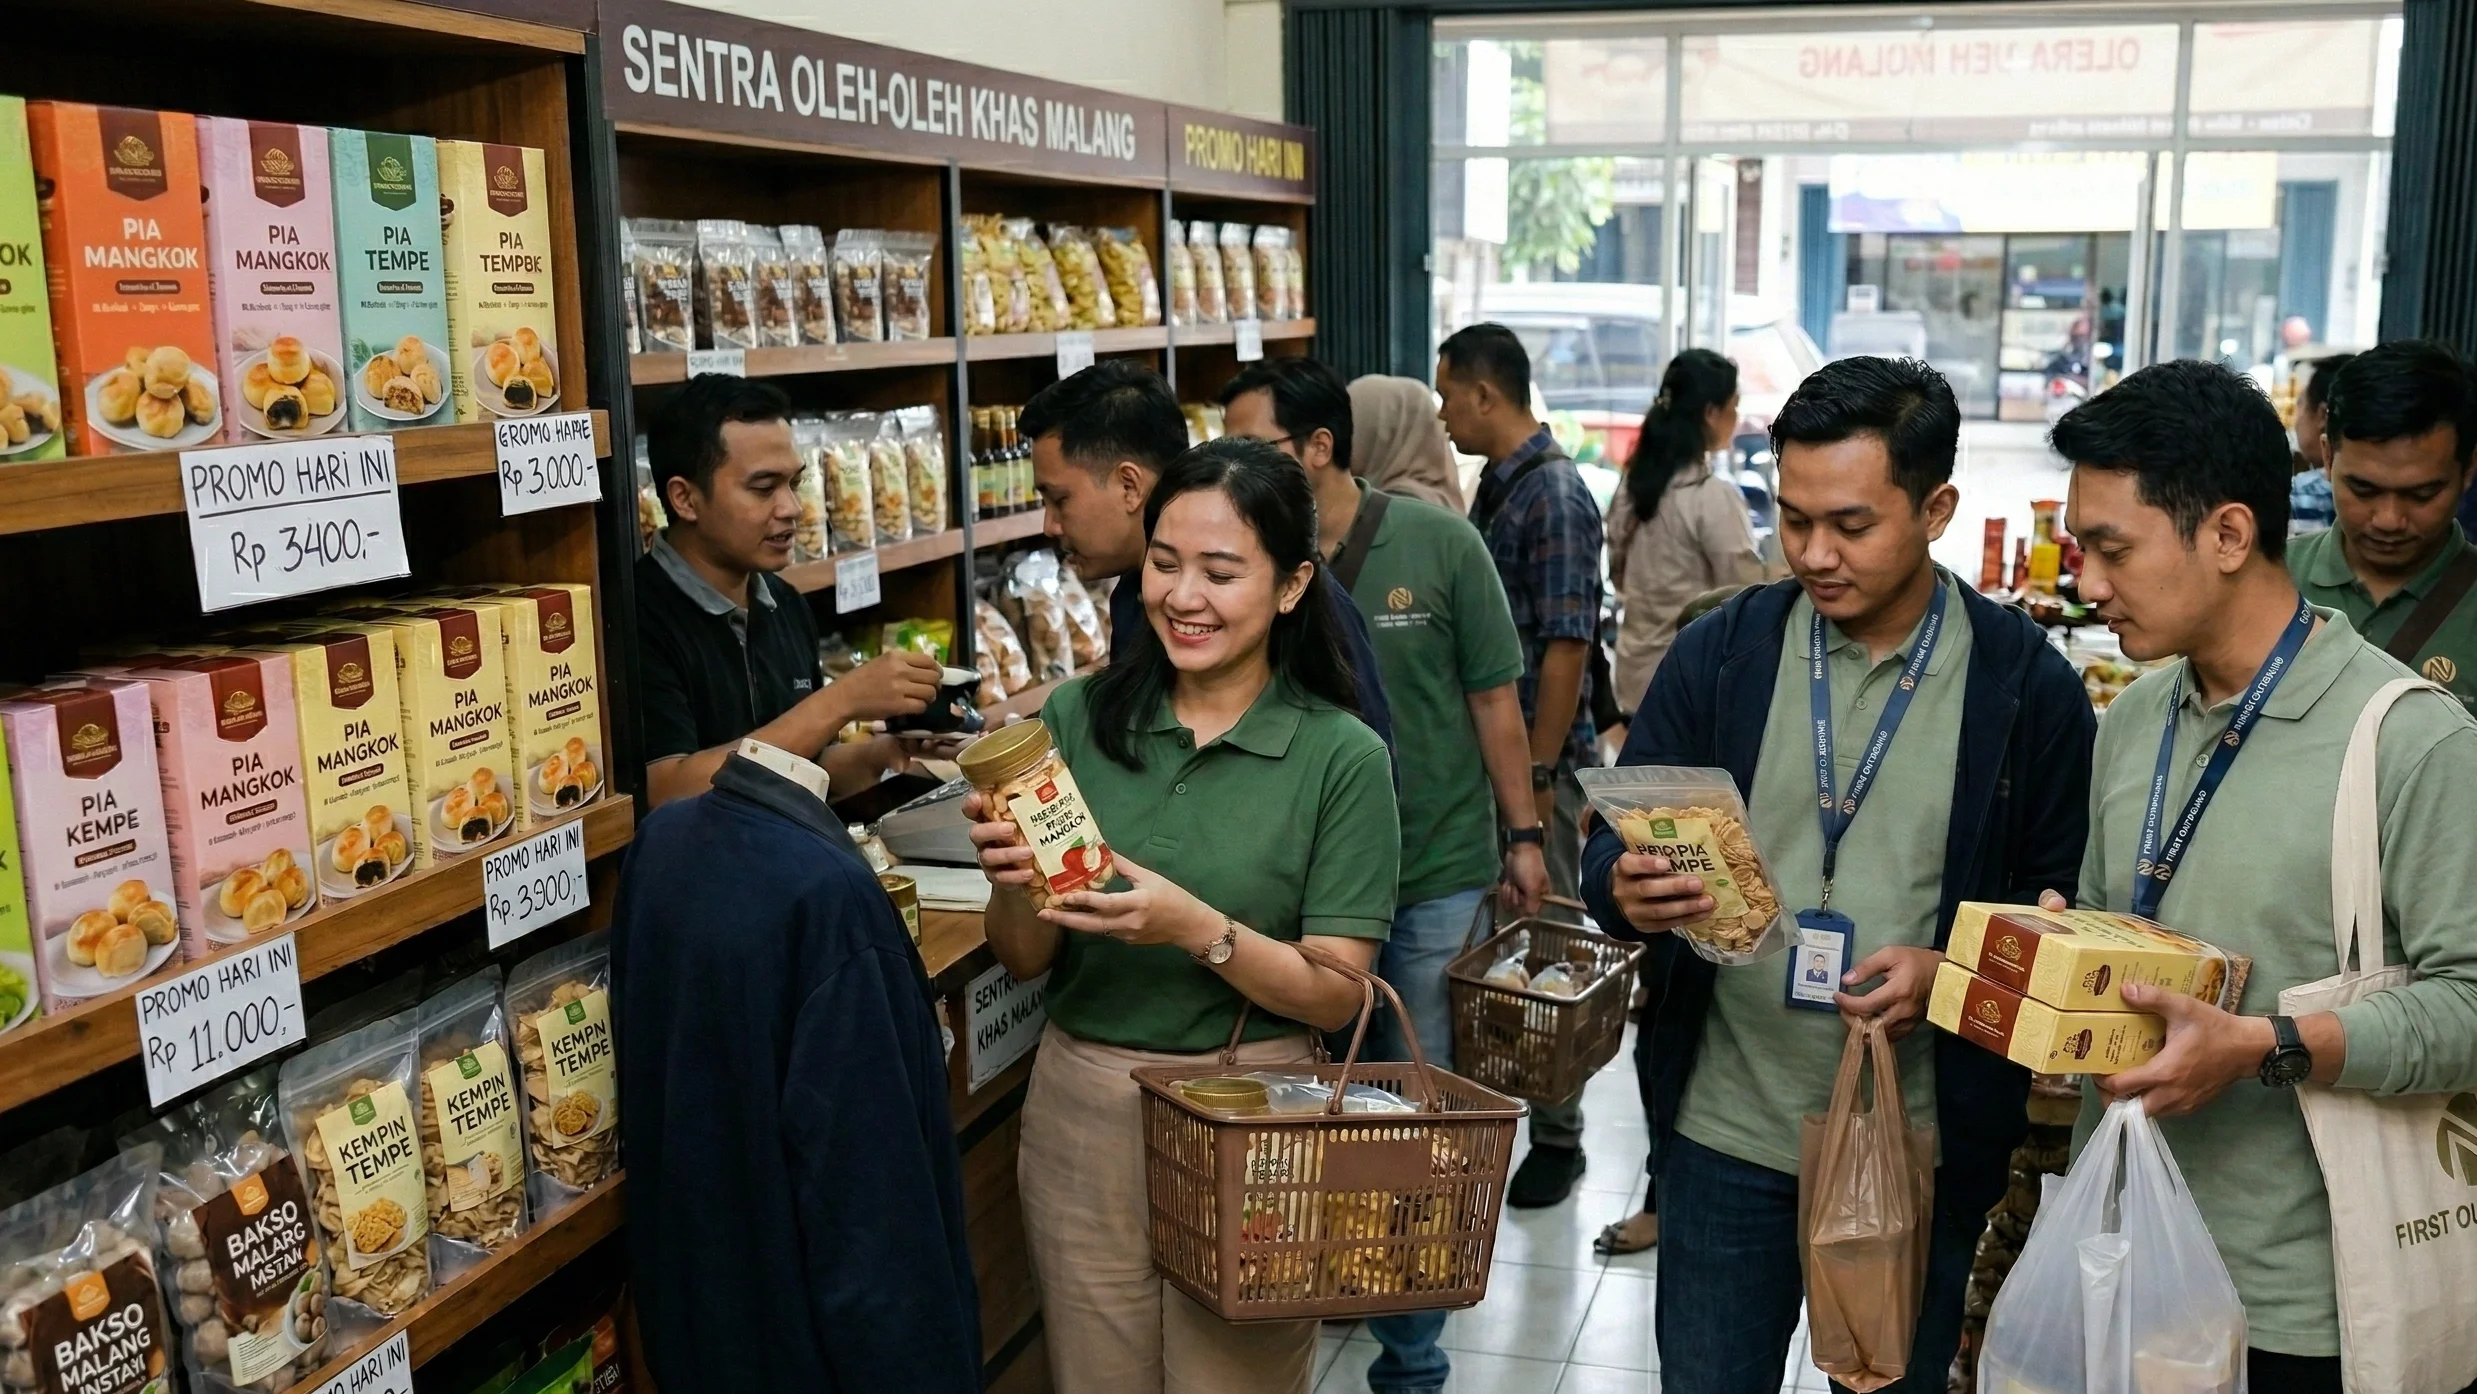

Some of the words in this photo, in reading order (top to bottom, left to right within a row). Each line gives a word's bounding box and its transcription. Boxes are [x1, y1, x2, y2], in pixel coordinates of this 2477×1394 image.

[623, 24, 784, 112] SENTRA
[791, 55, 963, 137] OLEH-OLEH
[970, 87, 1039, 148] KHAS
[1045, 100, 1136, 161] MALANG
[1185, 124, 1244, 173] PROMO
[1246, 134, 1282, 178] HARI
[123, 217, 162, 241] PIA
[268, 225, 300, 245] PIA
[383, 226, 411, 246] PIA
[500, 231, 523, 249] PIA
[84, 245, 199, 269] MANGKOK
[236, 250, 330, 272] MANGKOK
[364, 249, 430, 271] TEMPE
[191, 459, 285, 508] PROMO
[360, 449, 391, 487] INI
[502, 459, 523, 496] Rp
[231, 530, 266, 582] Rp
[528, 675, 594, 708] MANGKOK
[550, 661, 572, 682] PIA
[454, 688, 479, 709] PIA
[343, 719, 371, 742] PIA
[430, 701, 502, 738] MANGKOK
[231, 752, 264, 777] PIA
[317, 732, 399, 774] MANGKOK
[81, 789, 117, 817] PIA
[201, 766, 295, 810] MANGKOK
[65, 808, 140, 847] KEMPE
[486, 846, 530, 885] PROMO
[535, 833, 562, 864] HARI
[566, 825, 580, 852] INI
[490, 893, 515, 926] Rp.
[141, 975, 210, 1025] PROMO
[218, 953, 261, 994] HARI
[268, 942, 292, 973] INI
[977, 1012, 1009, 1055] KHAS
[148, 1036, 177, 1074] Rp
[555, 1037, 611, 1077] TEMPE
[446, 1071, 506, 1116] KEMPIN
[450, 1091, 511, 1136] TEMPE
[338, 1115, 408, 1164] KEMPIN
[345, 1136, 414, 1185] TEMPE
[226, 1200, 298, 1260] BAKSO
[2395, 1209, 2450, 1250] FIRST
[54, 1303, 144, 1371] BAKSO
[60, 1327, 151, 1393] MALANG
[350, 1353, 383, 1394] HARI
[386, 1337, 406, 1371] INI
